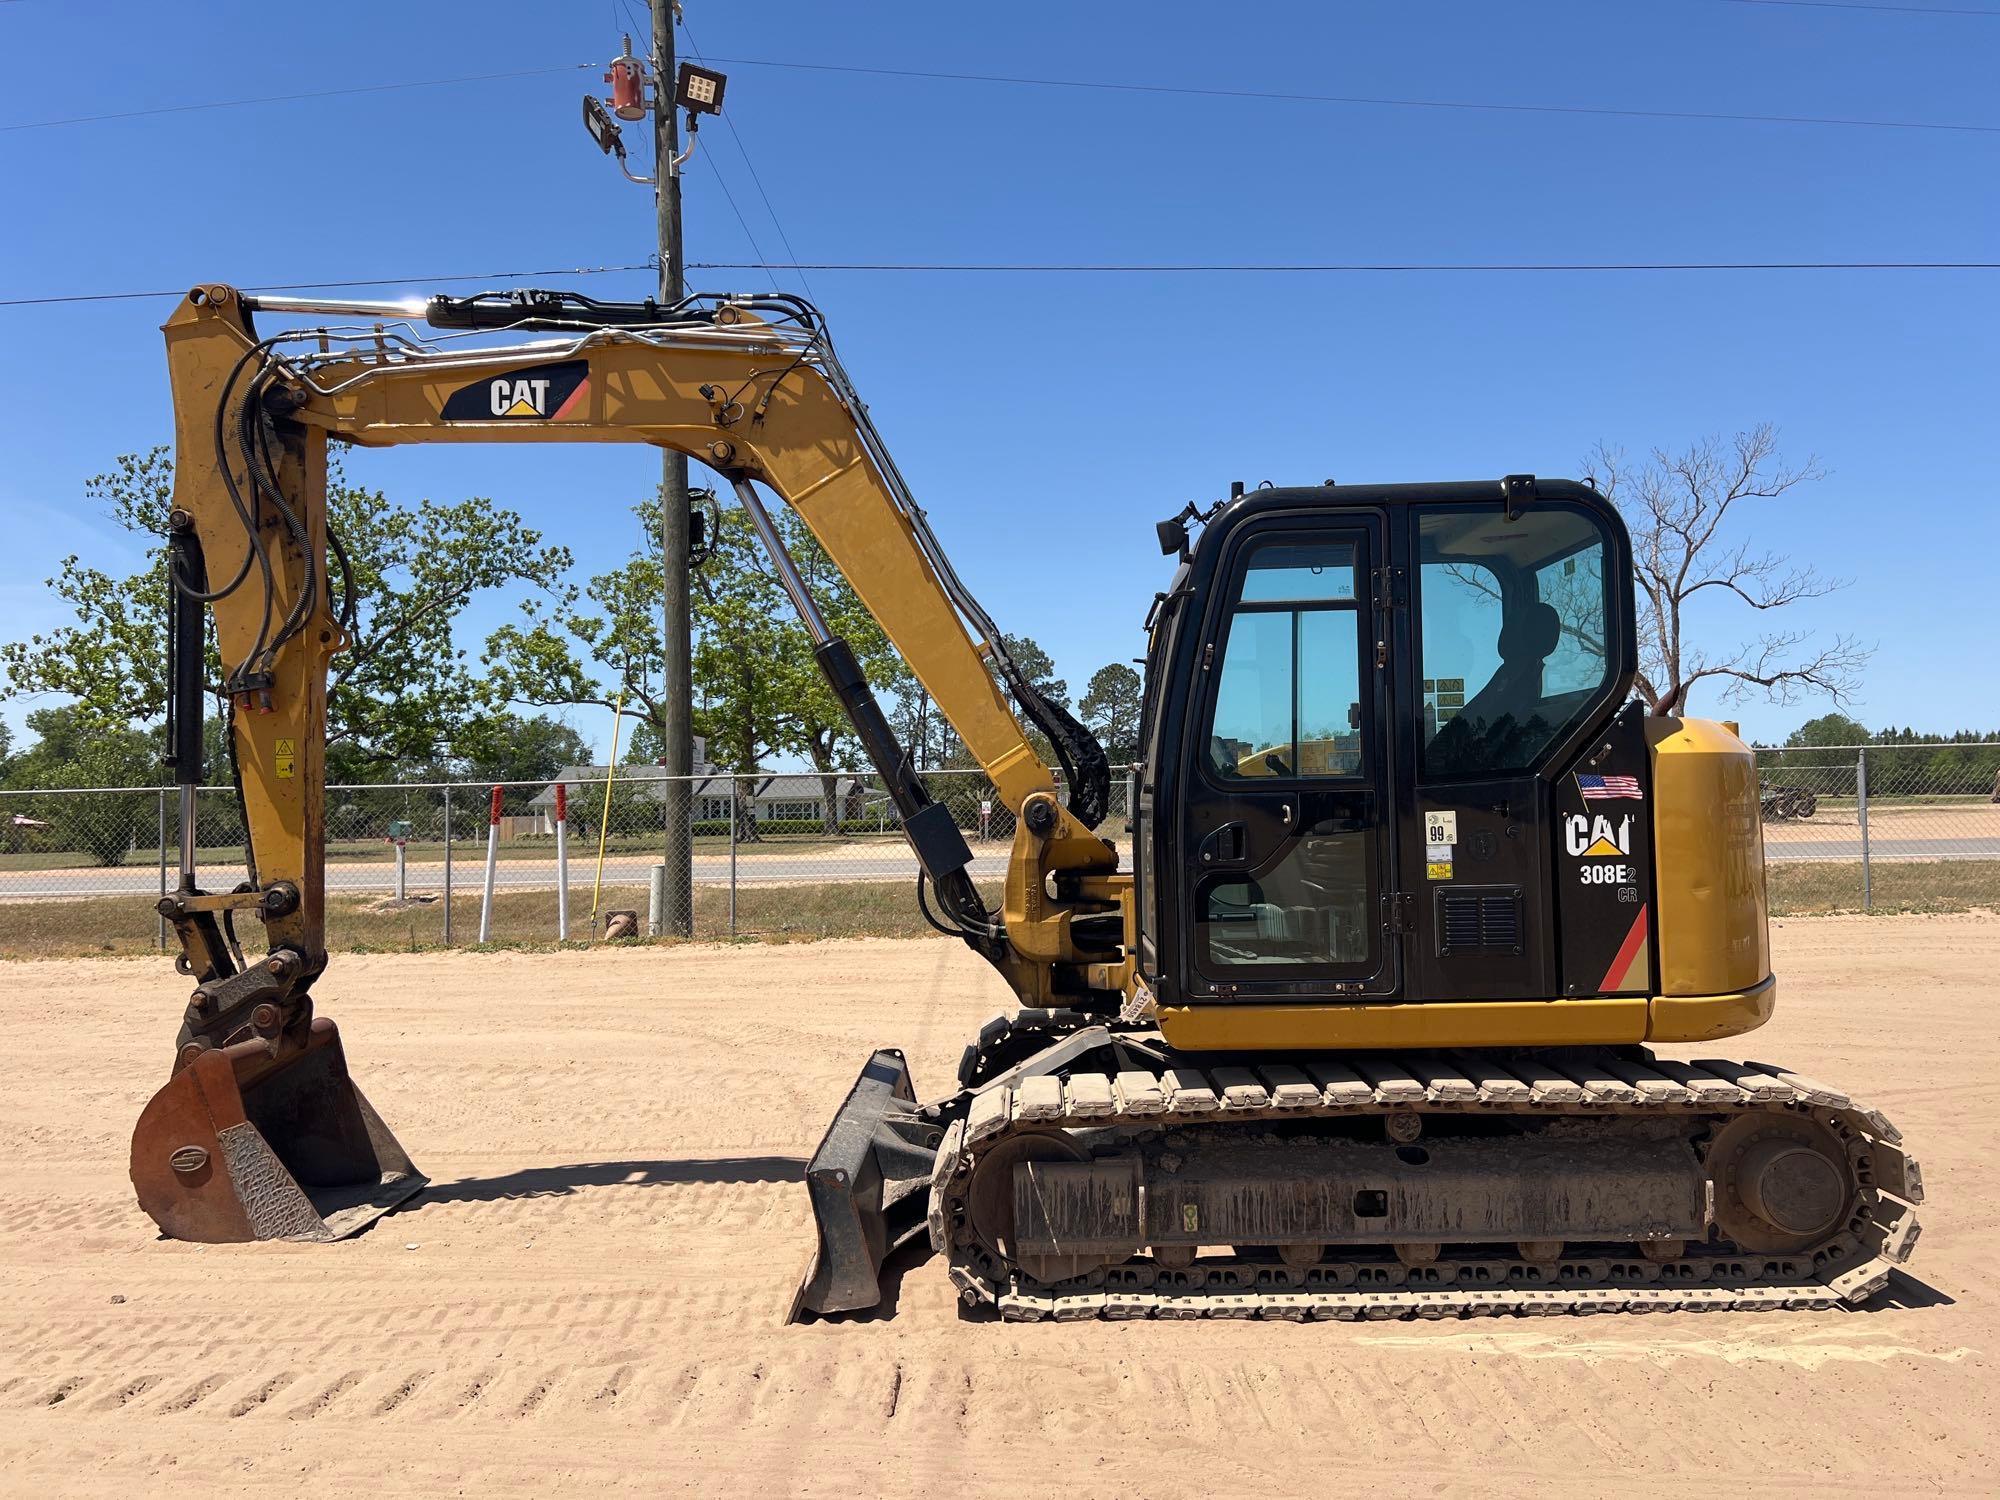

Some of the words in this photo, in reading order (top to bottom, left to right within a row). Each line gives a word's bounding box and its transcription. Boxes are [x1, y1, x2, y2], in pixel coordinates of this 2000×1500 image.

[490, 379, 550, 416] CAT
[1430, 825, 1444, 842] 99
[1617, 887, 1638, 903] CR
